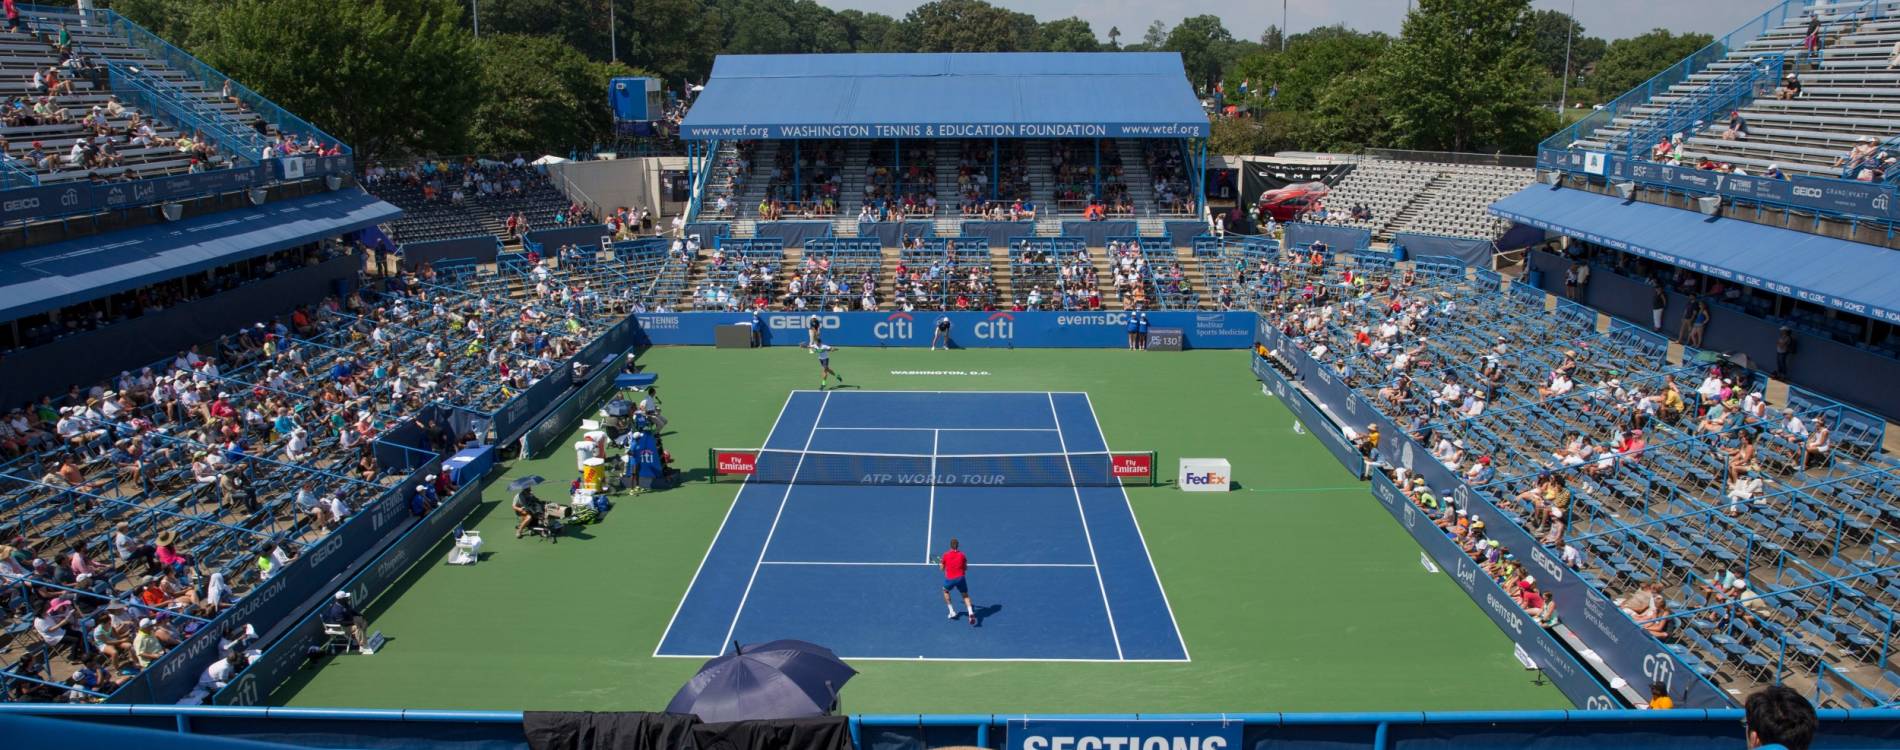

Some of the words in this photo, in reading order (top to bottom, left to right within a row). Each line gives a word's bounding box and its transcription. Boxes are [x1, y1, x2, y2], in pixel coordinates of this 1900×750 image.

[691, 125, 769, 138] www.wtef.org
[780, 125, 869, 137] WASHINGTON
[875, 125, 921, 137] TENNIS
[925, 125, 935, 137] &
[939, 125, 1015, 137] EDUCATION
[1020, 125, 1106, 137] FOUNDATION
[1121, 124, 1199, 137] www.wtef.org
[1793, 186, 1822, 198] GEICO
[3, 197, 40, 212] GEICO
[60, 191, 78, 207] citi
[1844, 301, 1865, 313] GOMEZ
[651, 316, 679, 324] TENNIS
[873, 315, 913, 339] citi
[974, 315, 1014, 339] citi
[1196, 328, 1218, 337] Sports
[1219, 328, 1249, 336] Medicine
[1163, 337, 1178, 345] 130
[640, 453, 654, 464] iti
[730, 456, 742, 464] Fly
[1125, 459, 1137, 467] Fly
[719, 462, 753, 471] Emirates
[1113, 465, 1148, 473] Emirates
[861, 474, 893, 483] ATP
[961, 474, 1005, 485] TOUR
[1186, 472, 1225, 485] FedEx
[382, 492, 404, 514] TENNIS
[310, 535, 343, 568] GEICO
[1531, 546, 1562, 582] GEICO
[1457, 558, 1476, 586] Live!
[350, 582, 369, 609] ILA
[1487, 593, 1523, 634] eventsDC
[1536, 636, 1554, 658] GRAND
[161, 652, 186, 680] ATP
[1643, 654, 1673, 693] citi
